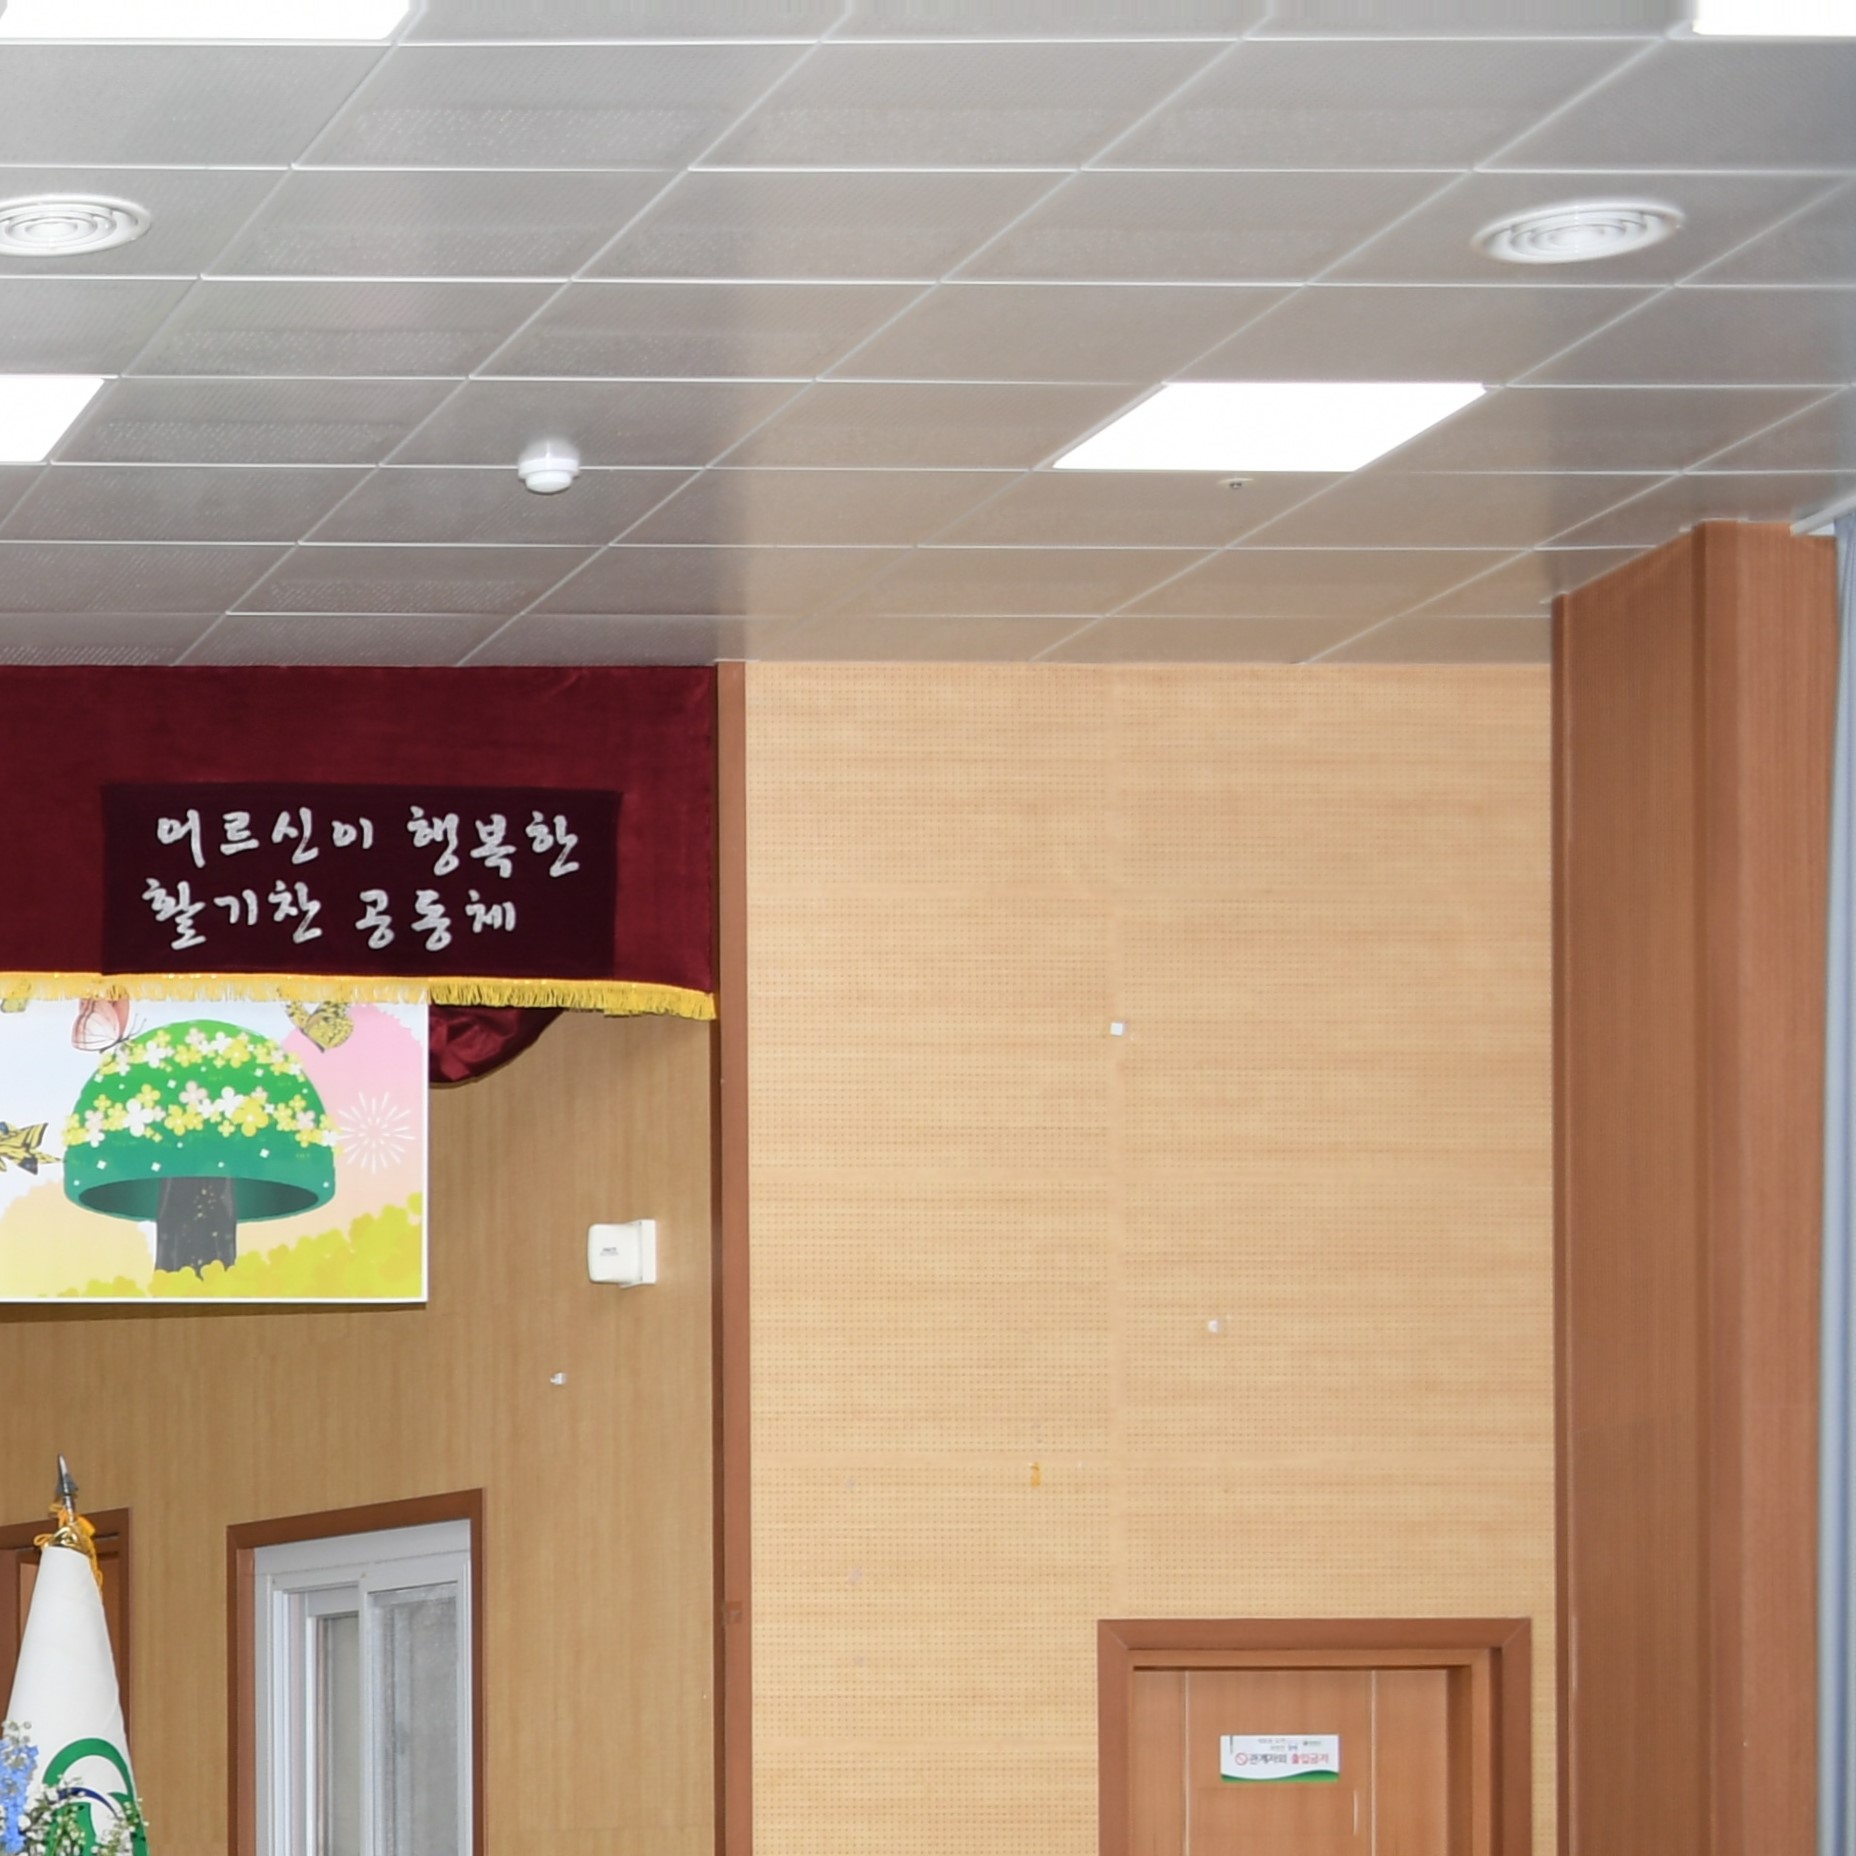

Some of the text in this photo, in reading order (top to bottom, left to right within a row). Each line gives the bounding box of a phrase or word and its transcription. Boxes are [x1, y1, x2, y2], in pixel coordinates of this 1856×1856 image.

[156, 805, 580, 878] 어르신이 행복한
[141, 877, 517, 951] 활기찬 공동체
